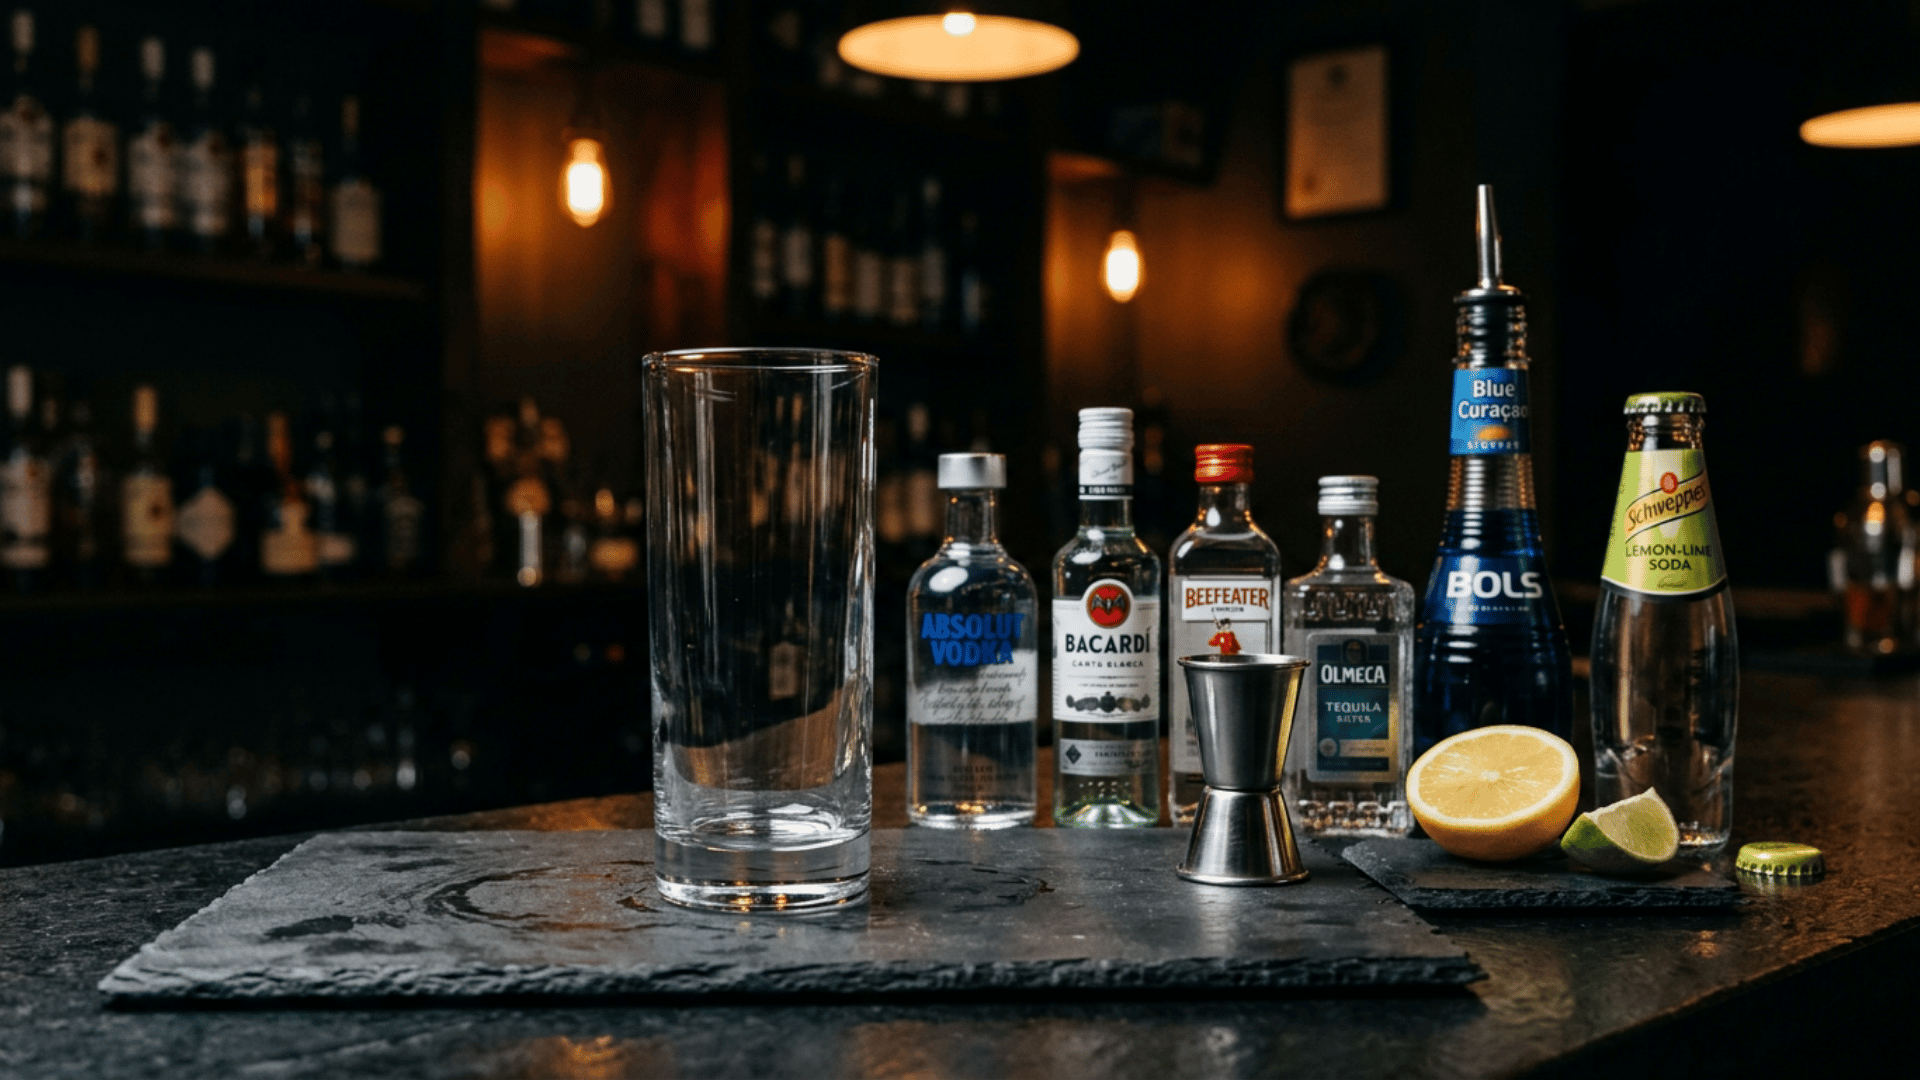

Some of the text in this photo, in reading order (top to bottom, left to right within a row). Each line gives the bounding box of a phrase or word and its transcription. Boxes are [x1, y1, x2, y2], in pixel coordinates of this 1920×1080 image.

[1473, 379, 1515, 397] Blue
[1650, 559, 1692, 571] SODA
[1446, 570, 1543, 598] BOLS
[1185, 587, 1269, 610] BEEFEATER
[921, 612, 1025, 640] ABSOLUT
[1065, 626, 1151, 653] BACARDÍ
[930, 640, 1014, 667] VODKA
[1320, 663, 1387, 684] OLMECA
[1325, 701, 1382, 713] TEQUILA
